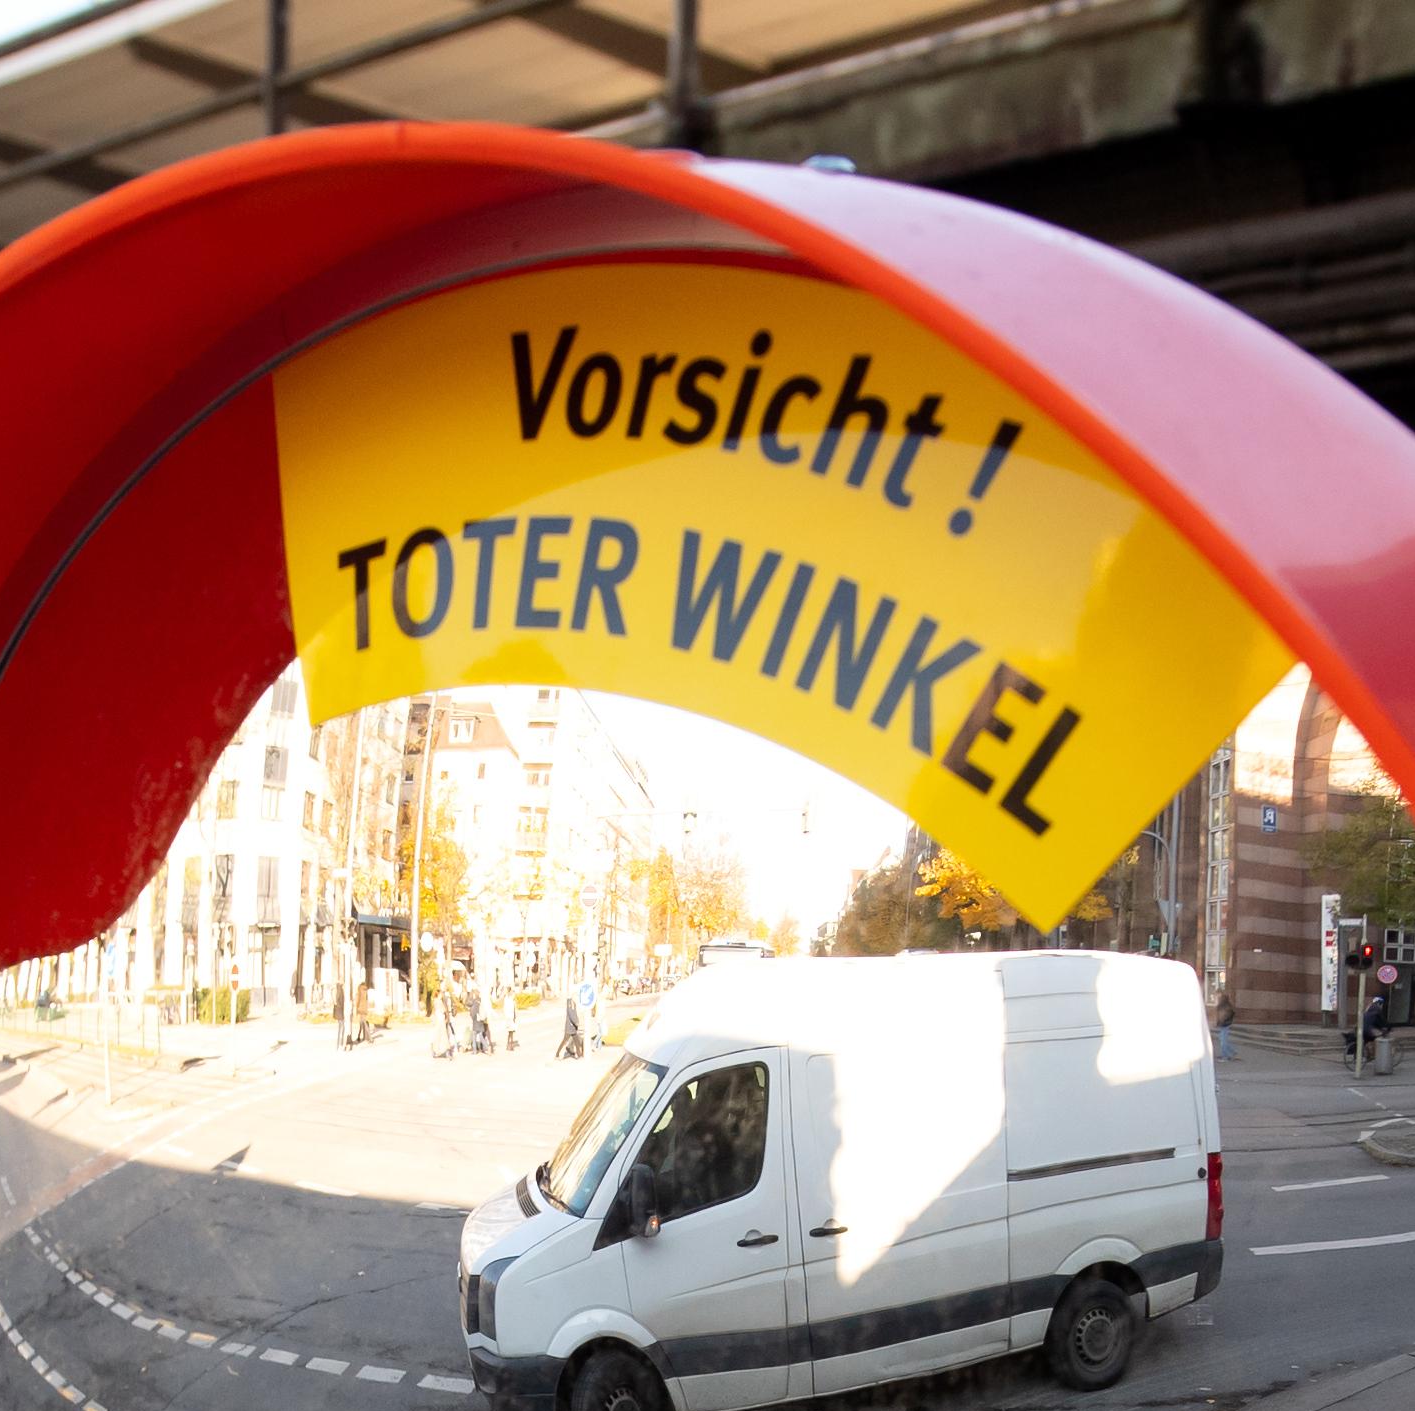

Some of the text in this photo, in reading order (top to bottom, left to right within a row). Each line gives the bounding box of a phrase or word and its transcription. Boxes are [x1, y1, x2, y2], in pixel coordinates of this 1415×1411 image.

[510, 326, 946, 509] Vorsicht
[337, 516, 1082, 838] TOTER WINKEL
